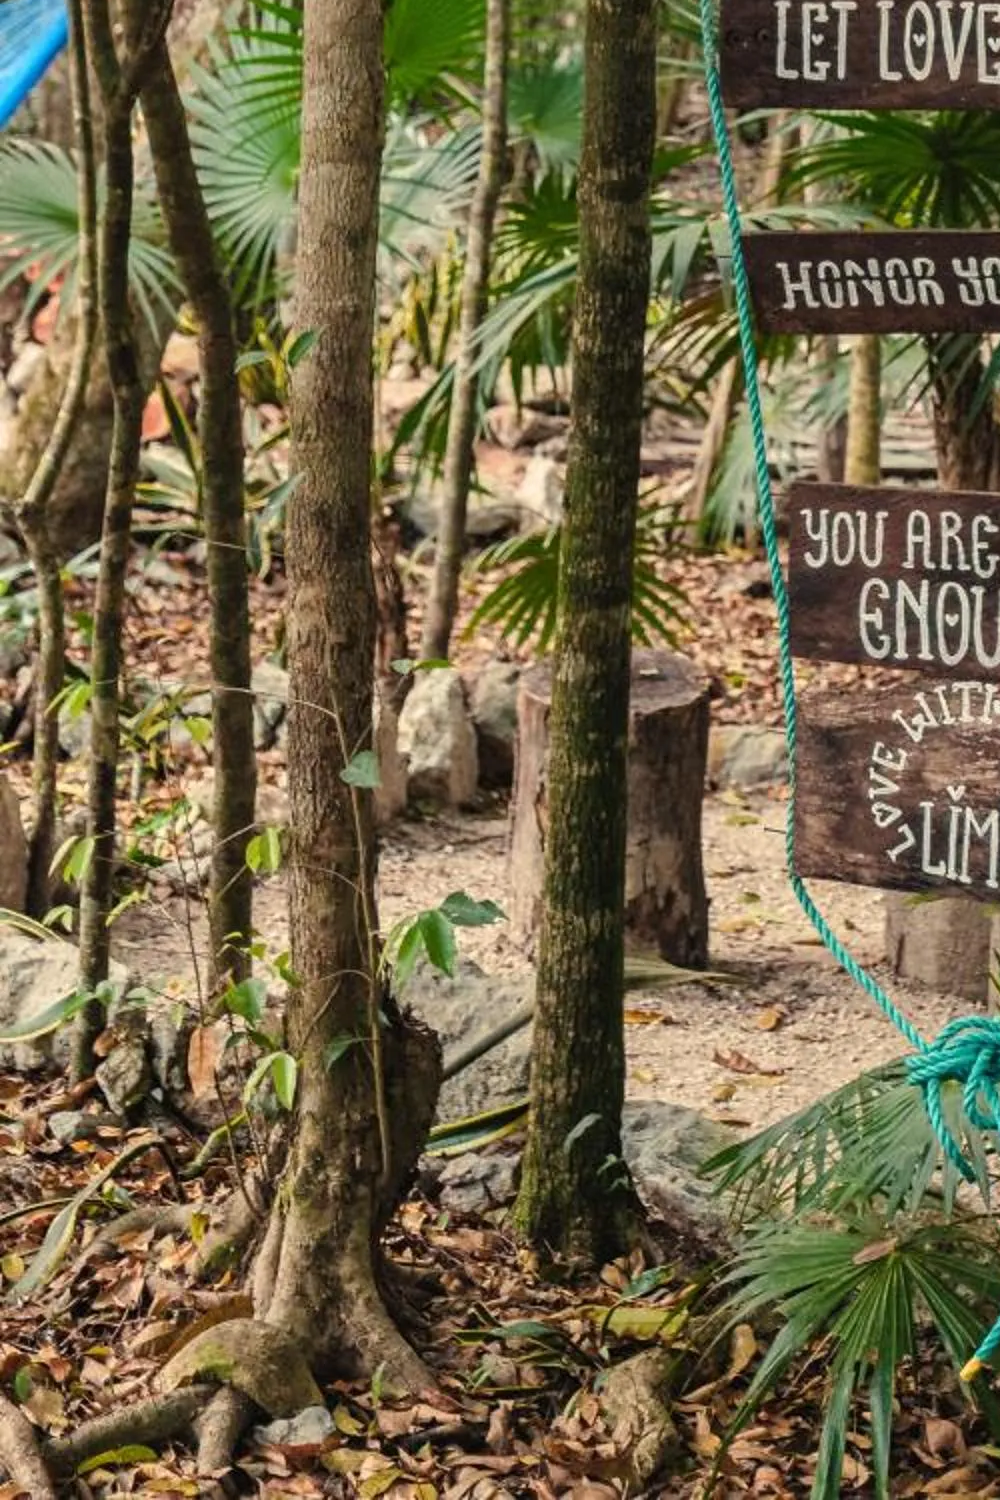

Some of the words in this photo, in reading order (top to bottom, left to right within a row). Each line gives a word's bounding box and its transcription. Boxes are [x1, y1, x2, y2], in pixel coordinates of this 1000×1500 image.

[774, 0, 858, 81] LET
[776, 258, 945, 310] HONOR
[800, 509, 889, 569] YOU
[901, 509, 1000, 579] ARE
[868, 741, 917, 863] LOVE
